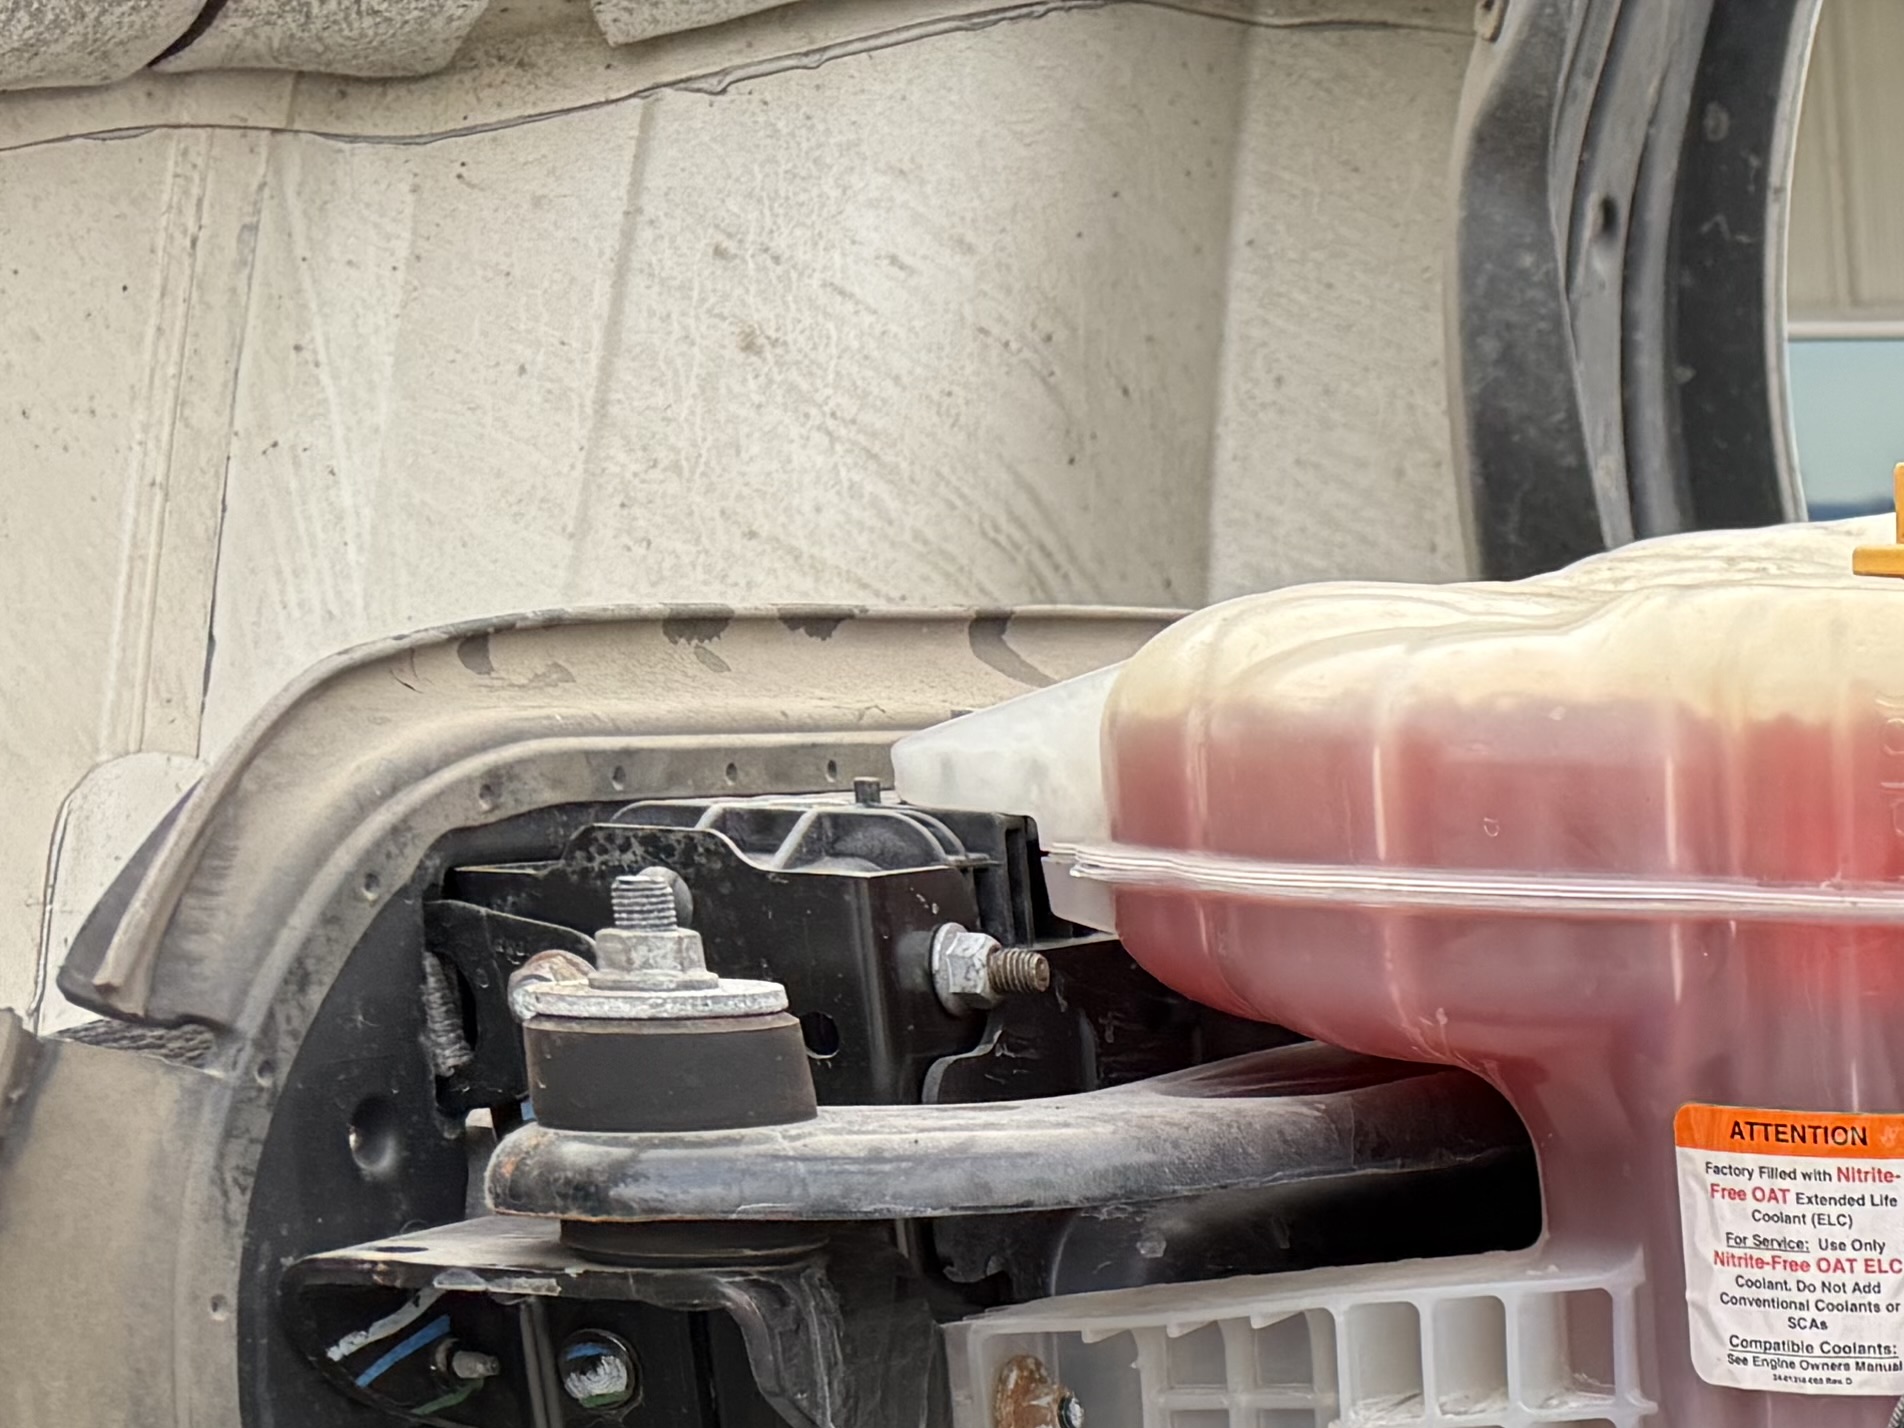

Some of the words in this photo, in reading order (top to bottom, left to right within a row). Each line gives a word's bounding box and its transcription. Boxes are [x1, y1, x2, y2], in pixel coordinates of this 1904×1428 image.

[1730, 1120, 1868, 1147] ATTENTION
[1705, 1162, 1754, 1182] Factory
[1759, 1166, 1797, 1182] Filled
[1801, 1168, 1832, 1182] with
[1836, 1166, 1902, 1184] Nitrite-
[1709, 1184, 1747, 1201] Free
[1752, 1187, 1790, 1205] OAT
[1795, 1192, 1866, 1208] Extended
[1870, 1194, 1898, 1208] Life
[1751, 1209, 1807, 1227] Coolant
[1811, 1212, 1853, 1229] (ELC)
[1726, 1233, 1749, 1248] For
[1752, 1234, 1809, 1251] Service:
[1818, 1238, 1846, 1252] Use
[1851, 1239, 1886, 1255] Only
[1713, 1251, 1811, 1272] Nitrite-Free
[1816, 1258, 1858, 1274] OAT
[1864, 1258, 1903, 1274] ELC
[1735, 1275, 1791, 1292] Coolant.
[1796, 1280, 1816, 1294] Do
[1821, 1281, 1847, 1294] Not
[1852, 1281, 1881, 1294] Add
[1720, 1292, 1810, 1312] Conventional
[1815, 1298, 1881, 1313] Coolants
[1886, 1302, 1901, 1313] or
[1788, 1316, 1828, 1331] SCAs
[1729, 1334, 1814, 1355] Compatible
[1819, 1341, 1898, 1356] Coolants:
[1728, 1354, 1748, 1367] See
[1752, 1356, 1796, 1372] Engine
[1799, 1359, 1851, 1372] Owners
[1855, 1360, 1902, 1372] Manual
